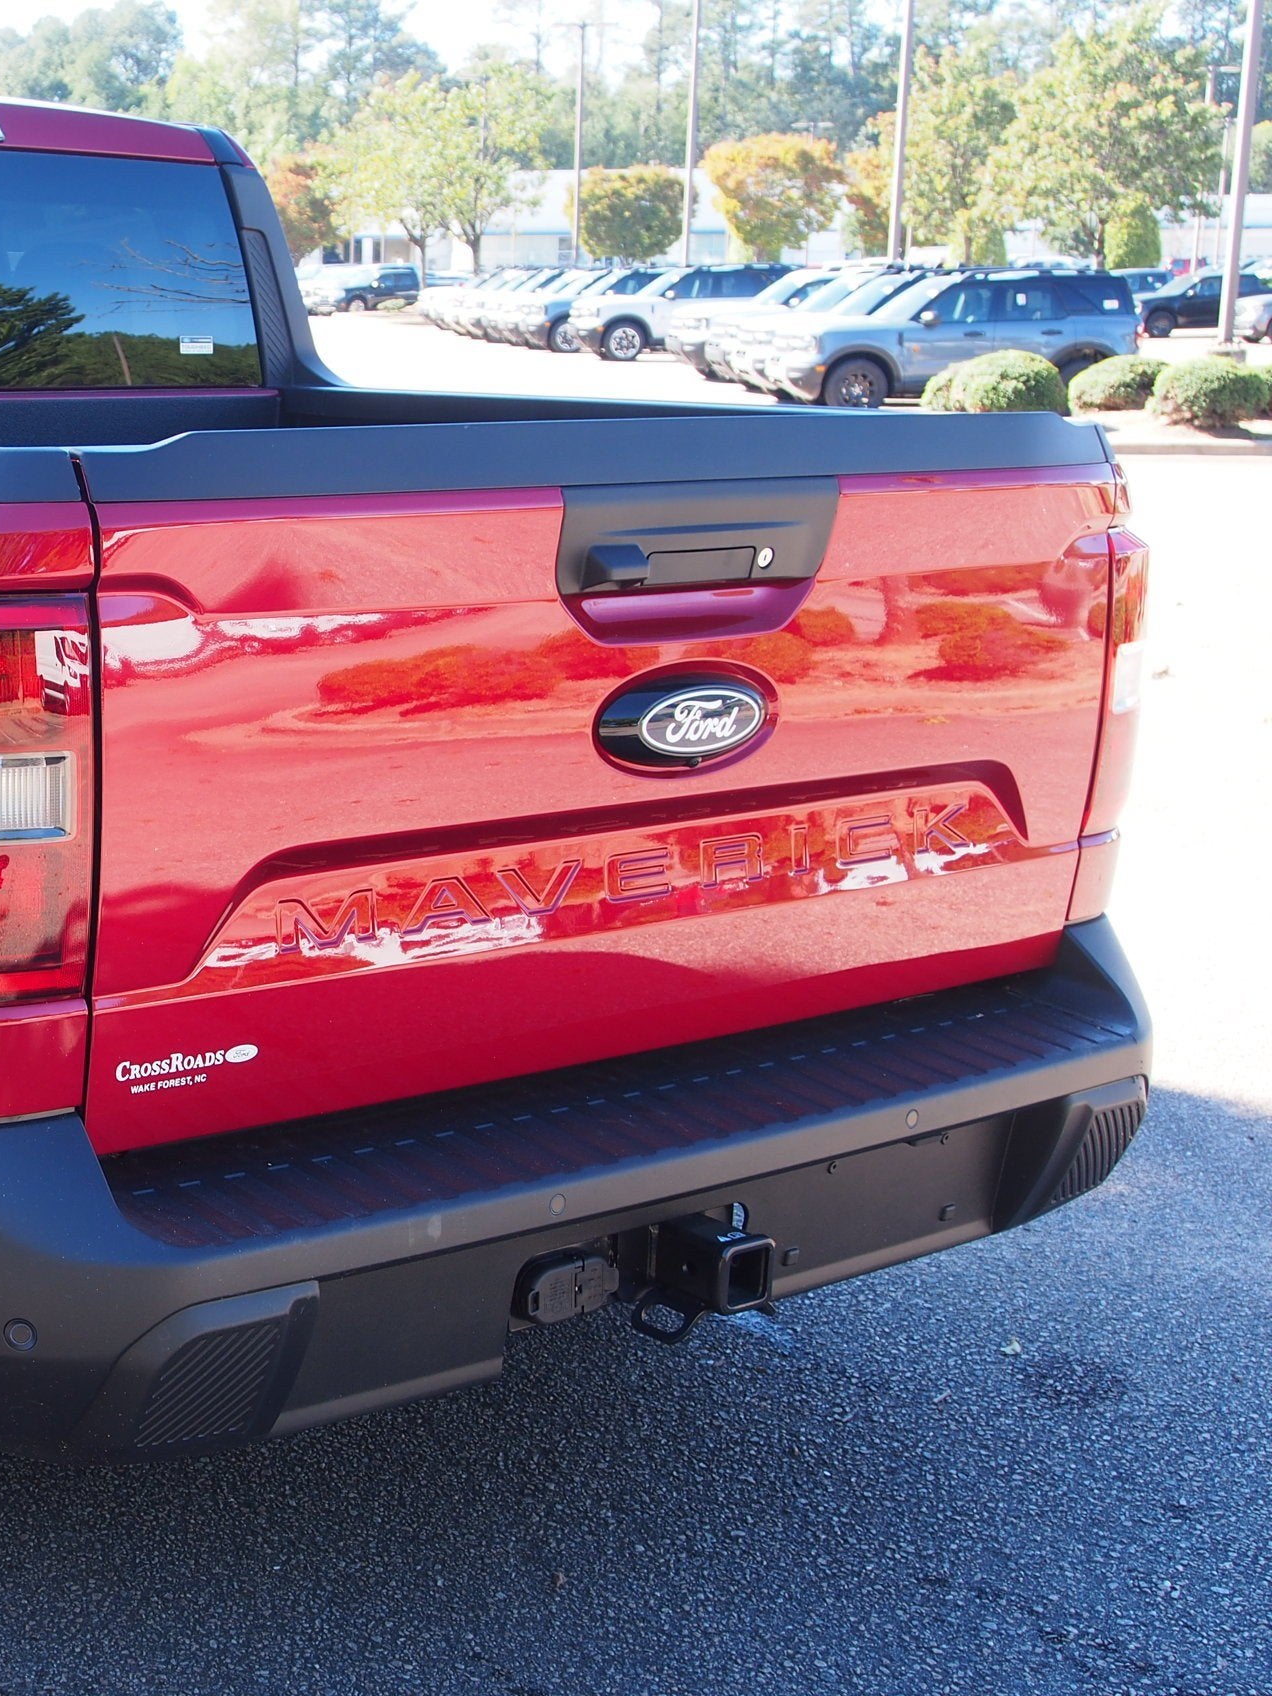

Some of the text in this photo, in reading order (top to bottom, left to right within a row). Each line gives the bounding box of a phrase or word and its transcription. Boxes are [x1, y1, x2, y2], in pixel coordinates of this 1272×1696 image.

[665, 699, 739, 744] Ford
[275, 803, 972, 955] MAVERICK
[130, 1073, 208, 1094] WAKE FOREST, NC
